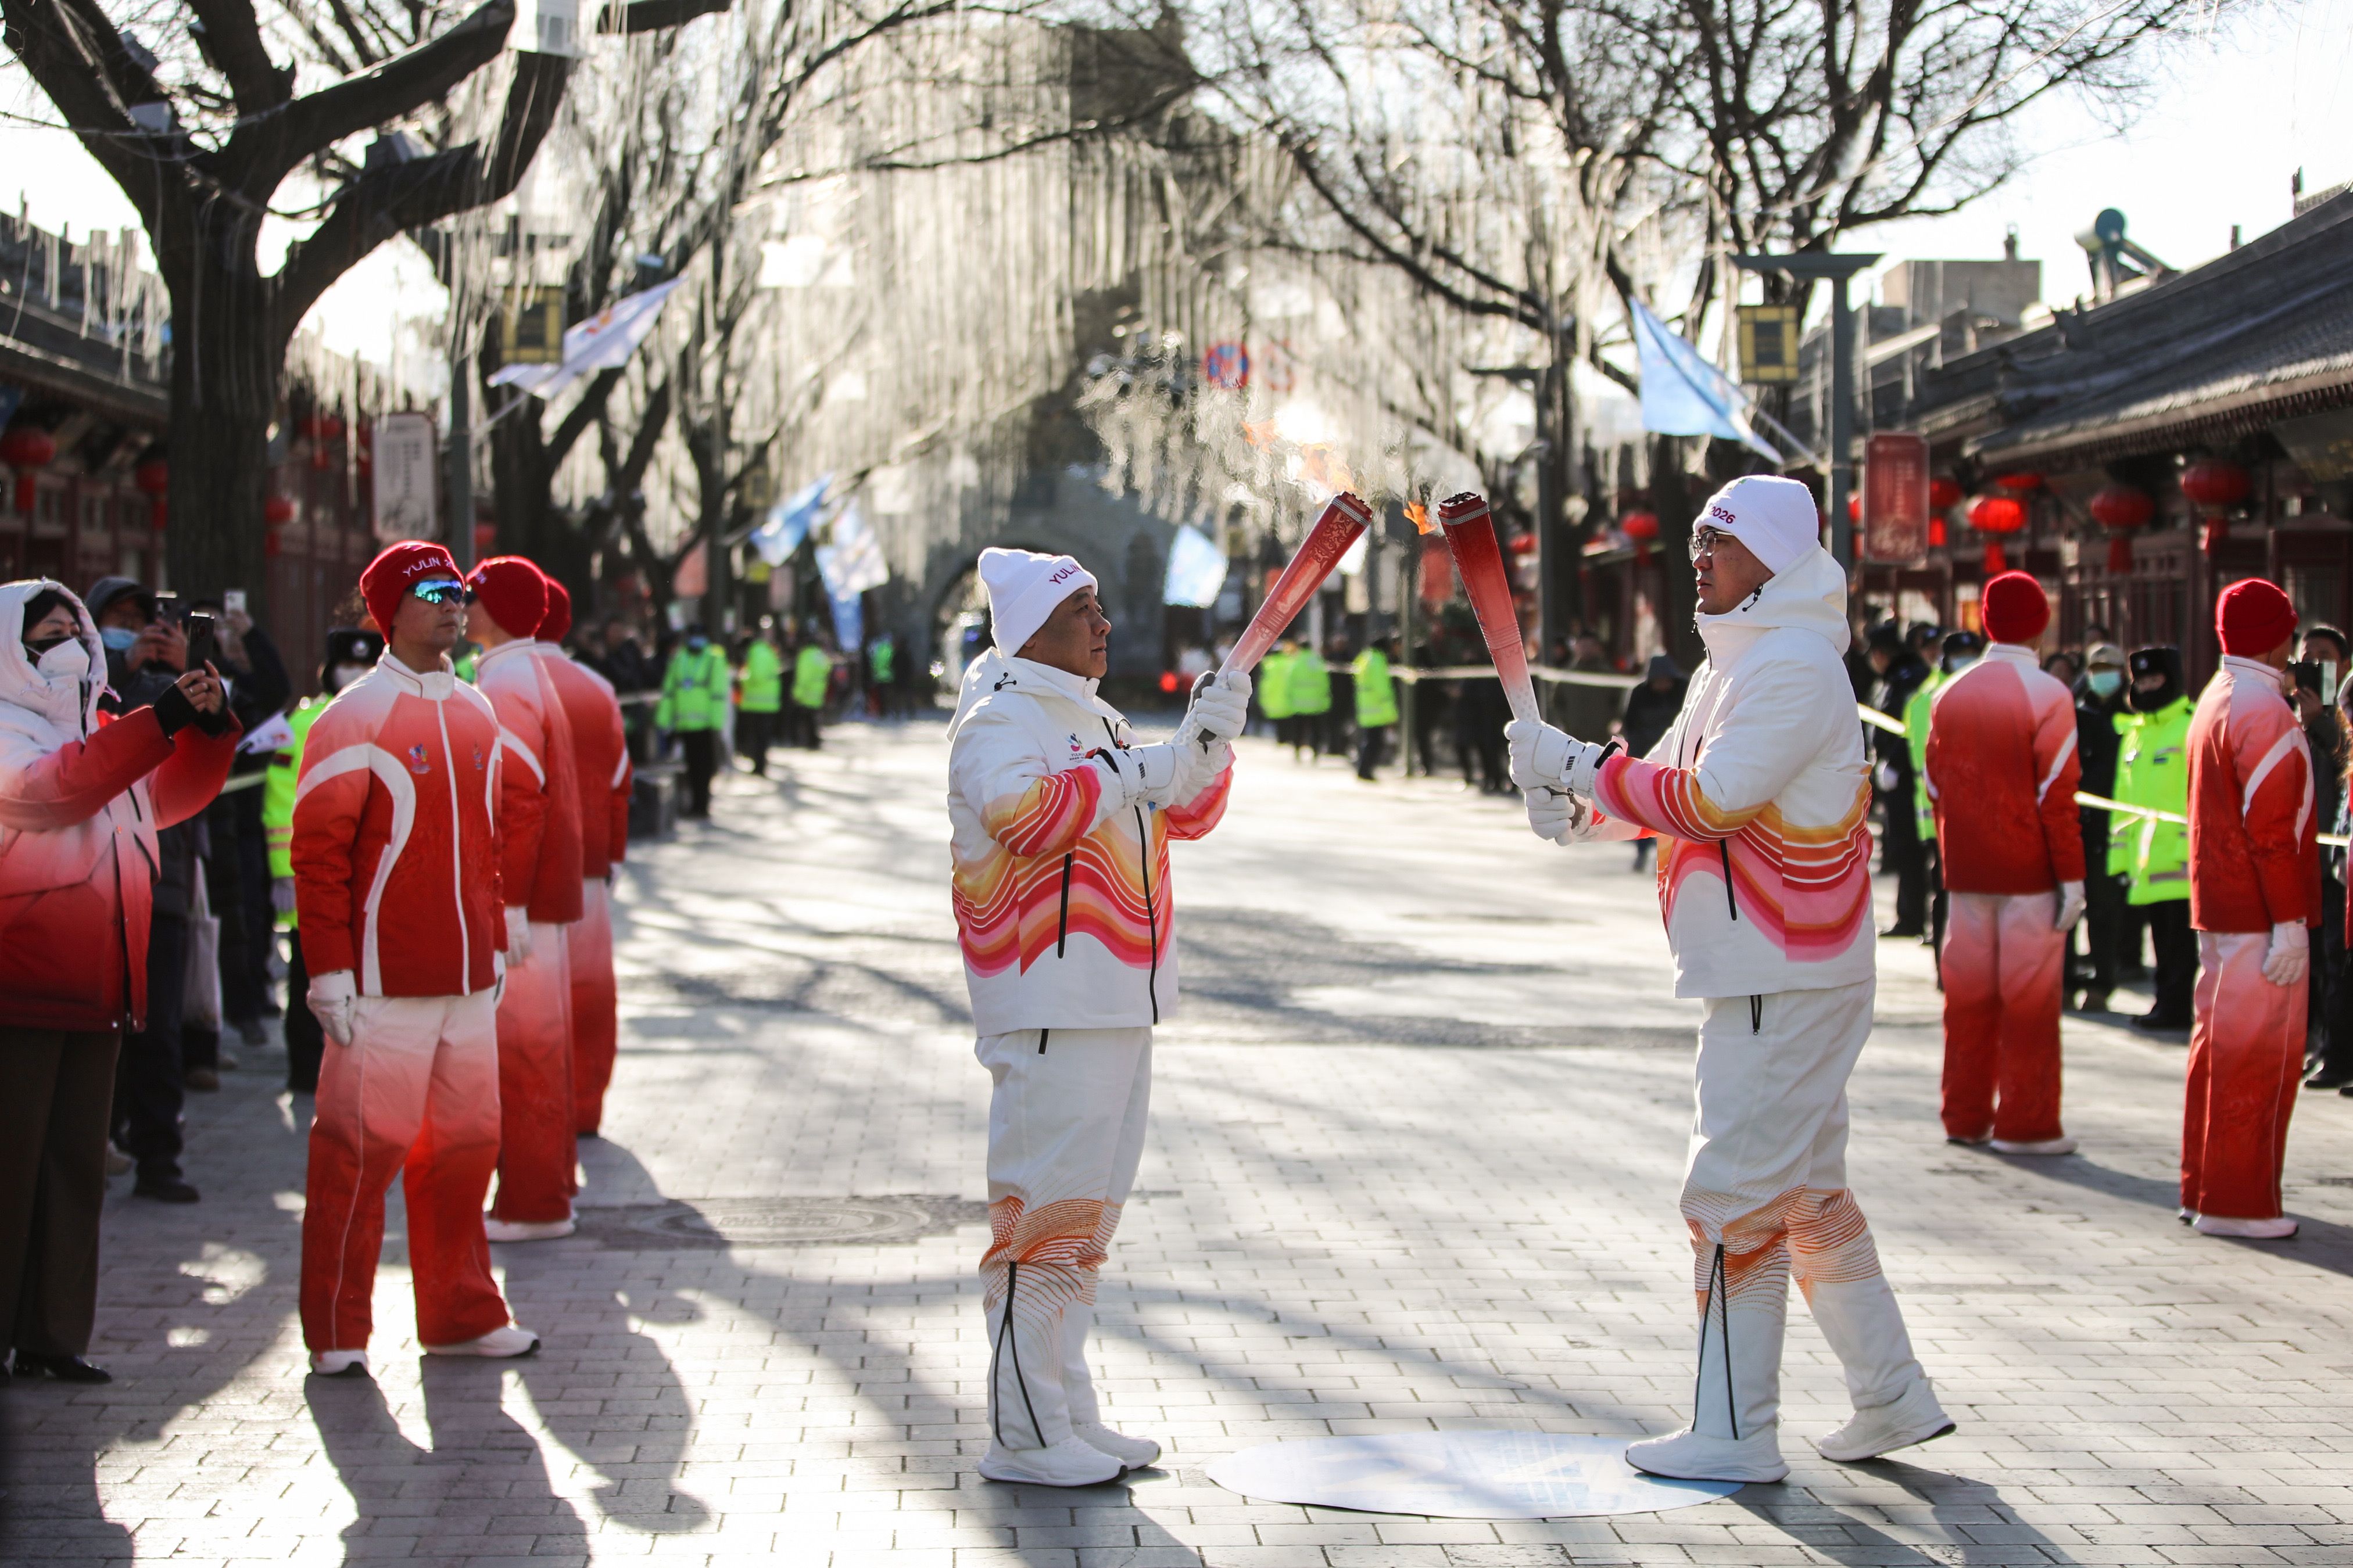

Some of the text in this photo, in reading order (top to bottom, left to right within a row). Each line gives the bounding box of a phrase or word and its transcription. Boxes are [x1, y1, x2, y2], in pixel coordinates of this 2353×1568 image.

[1709, 505, 1736, 524] 2026
[403, 557, 441, 577] YULIN
[1049, 564, 1083, 584] YULIN
